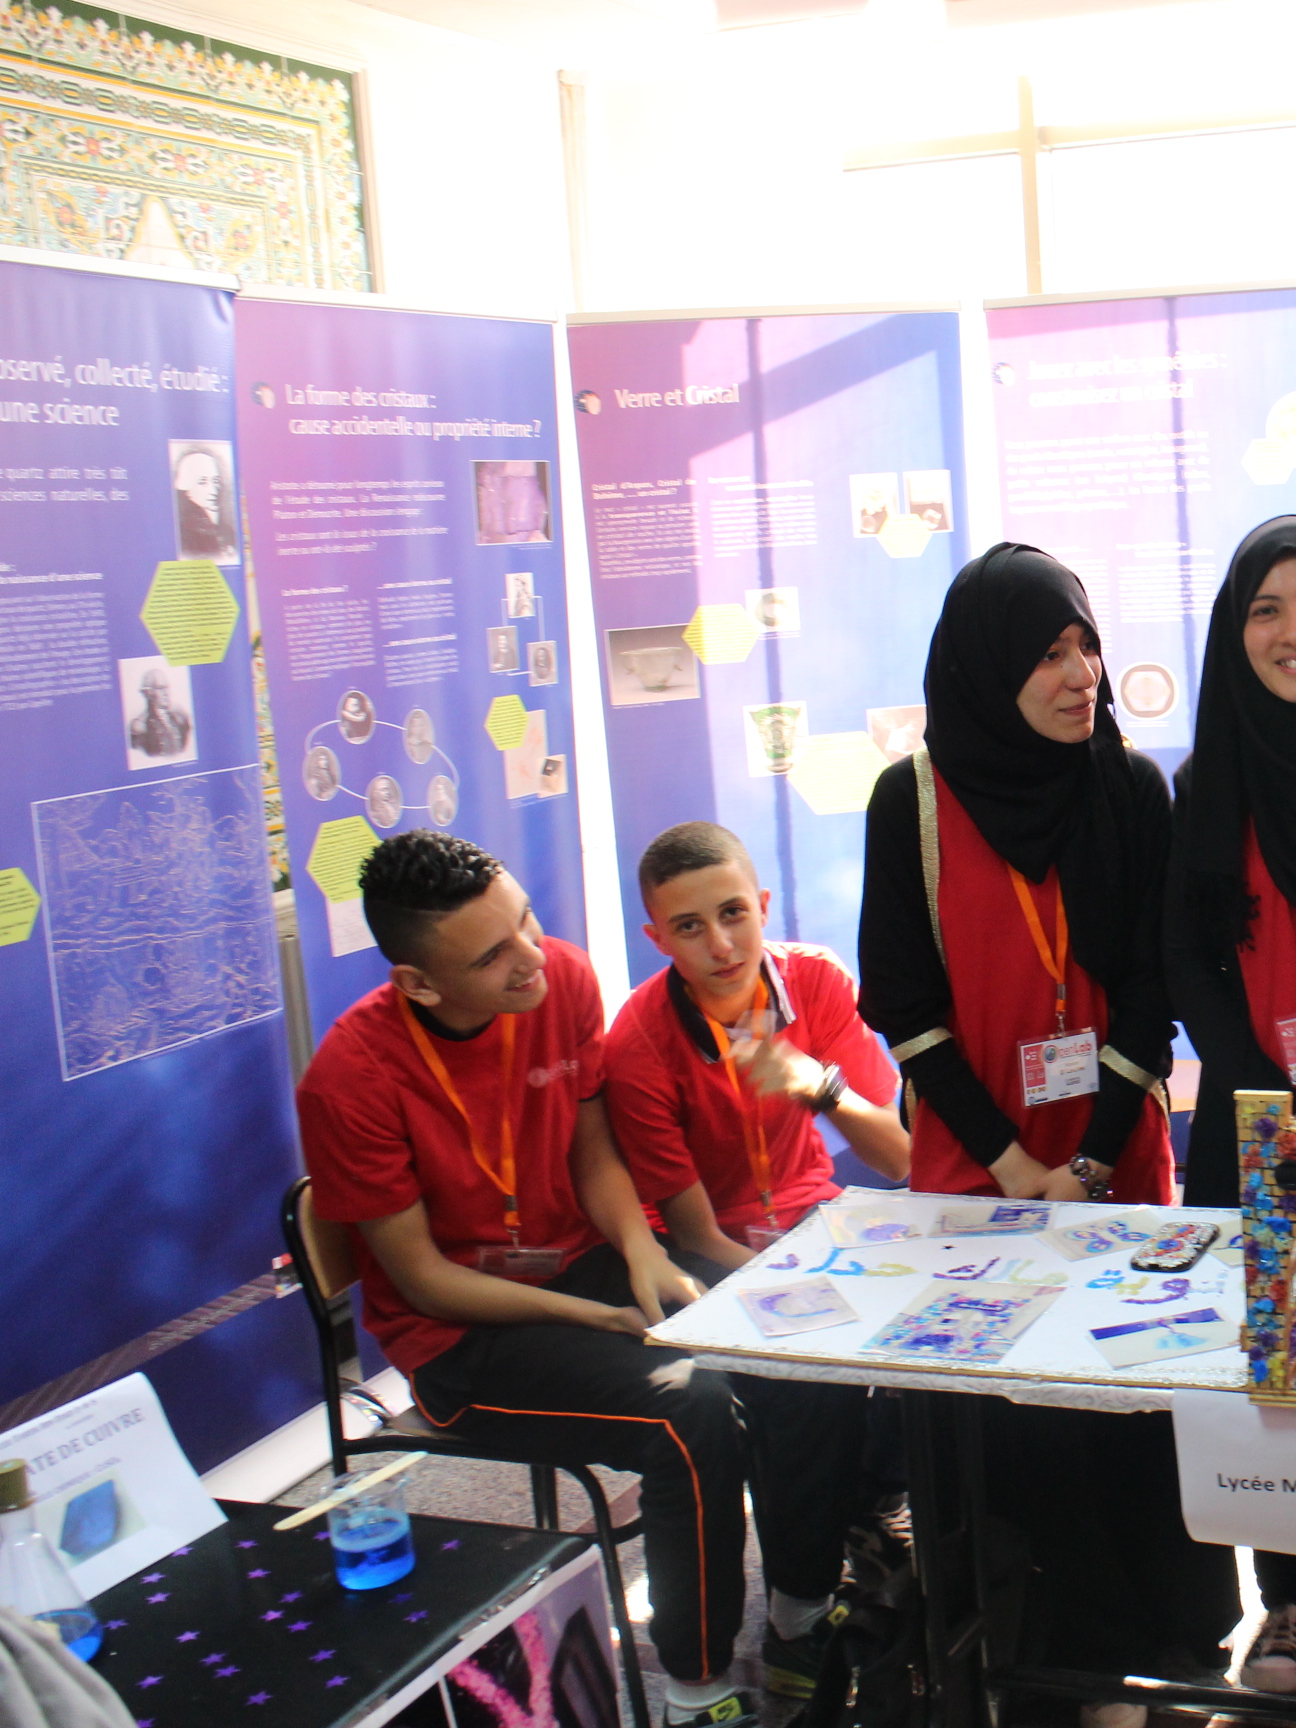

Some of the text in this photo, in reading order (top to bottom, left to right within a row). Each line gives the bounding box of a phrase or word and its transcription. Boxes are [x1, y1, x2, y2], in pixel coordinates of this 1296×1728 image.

[75, 358, 158, 393] collecté,
[285, 384, 306, 405] La
[306, 384, 350, 406] forme
[351, 386, 377, 406] des
[614, 383, 739, 408] Verre et Cristal
[44, 397, 120, 426] science
[288, 418, 331, 435] cause
[331, 415, 414, 436] accidentelle
[414, 421, 431, 437] ou
[432, 417, 491, 441] propriété
[57, 1438, 84, 1459] DE
[83, 1407, 146, 1446] CUIVRE
[1216, 1472, 1275, 1493] Lycée
